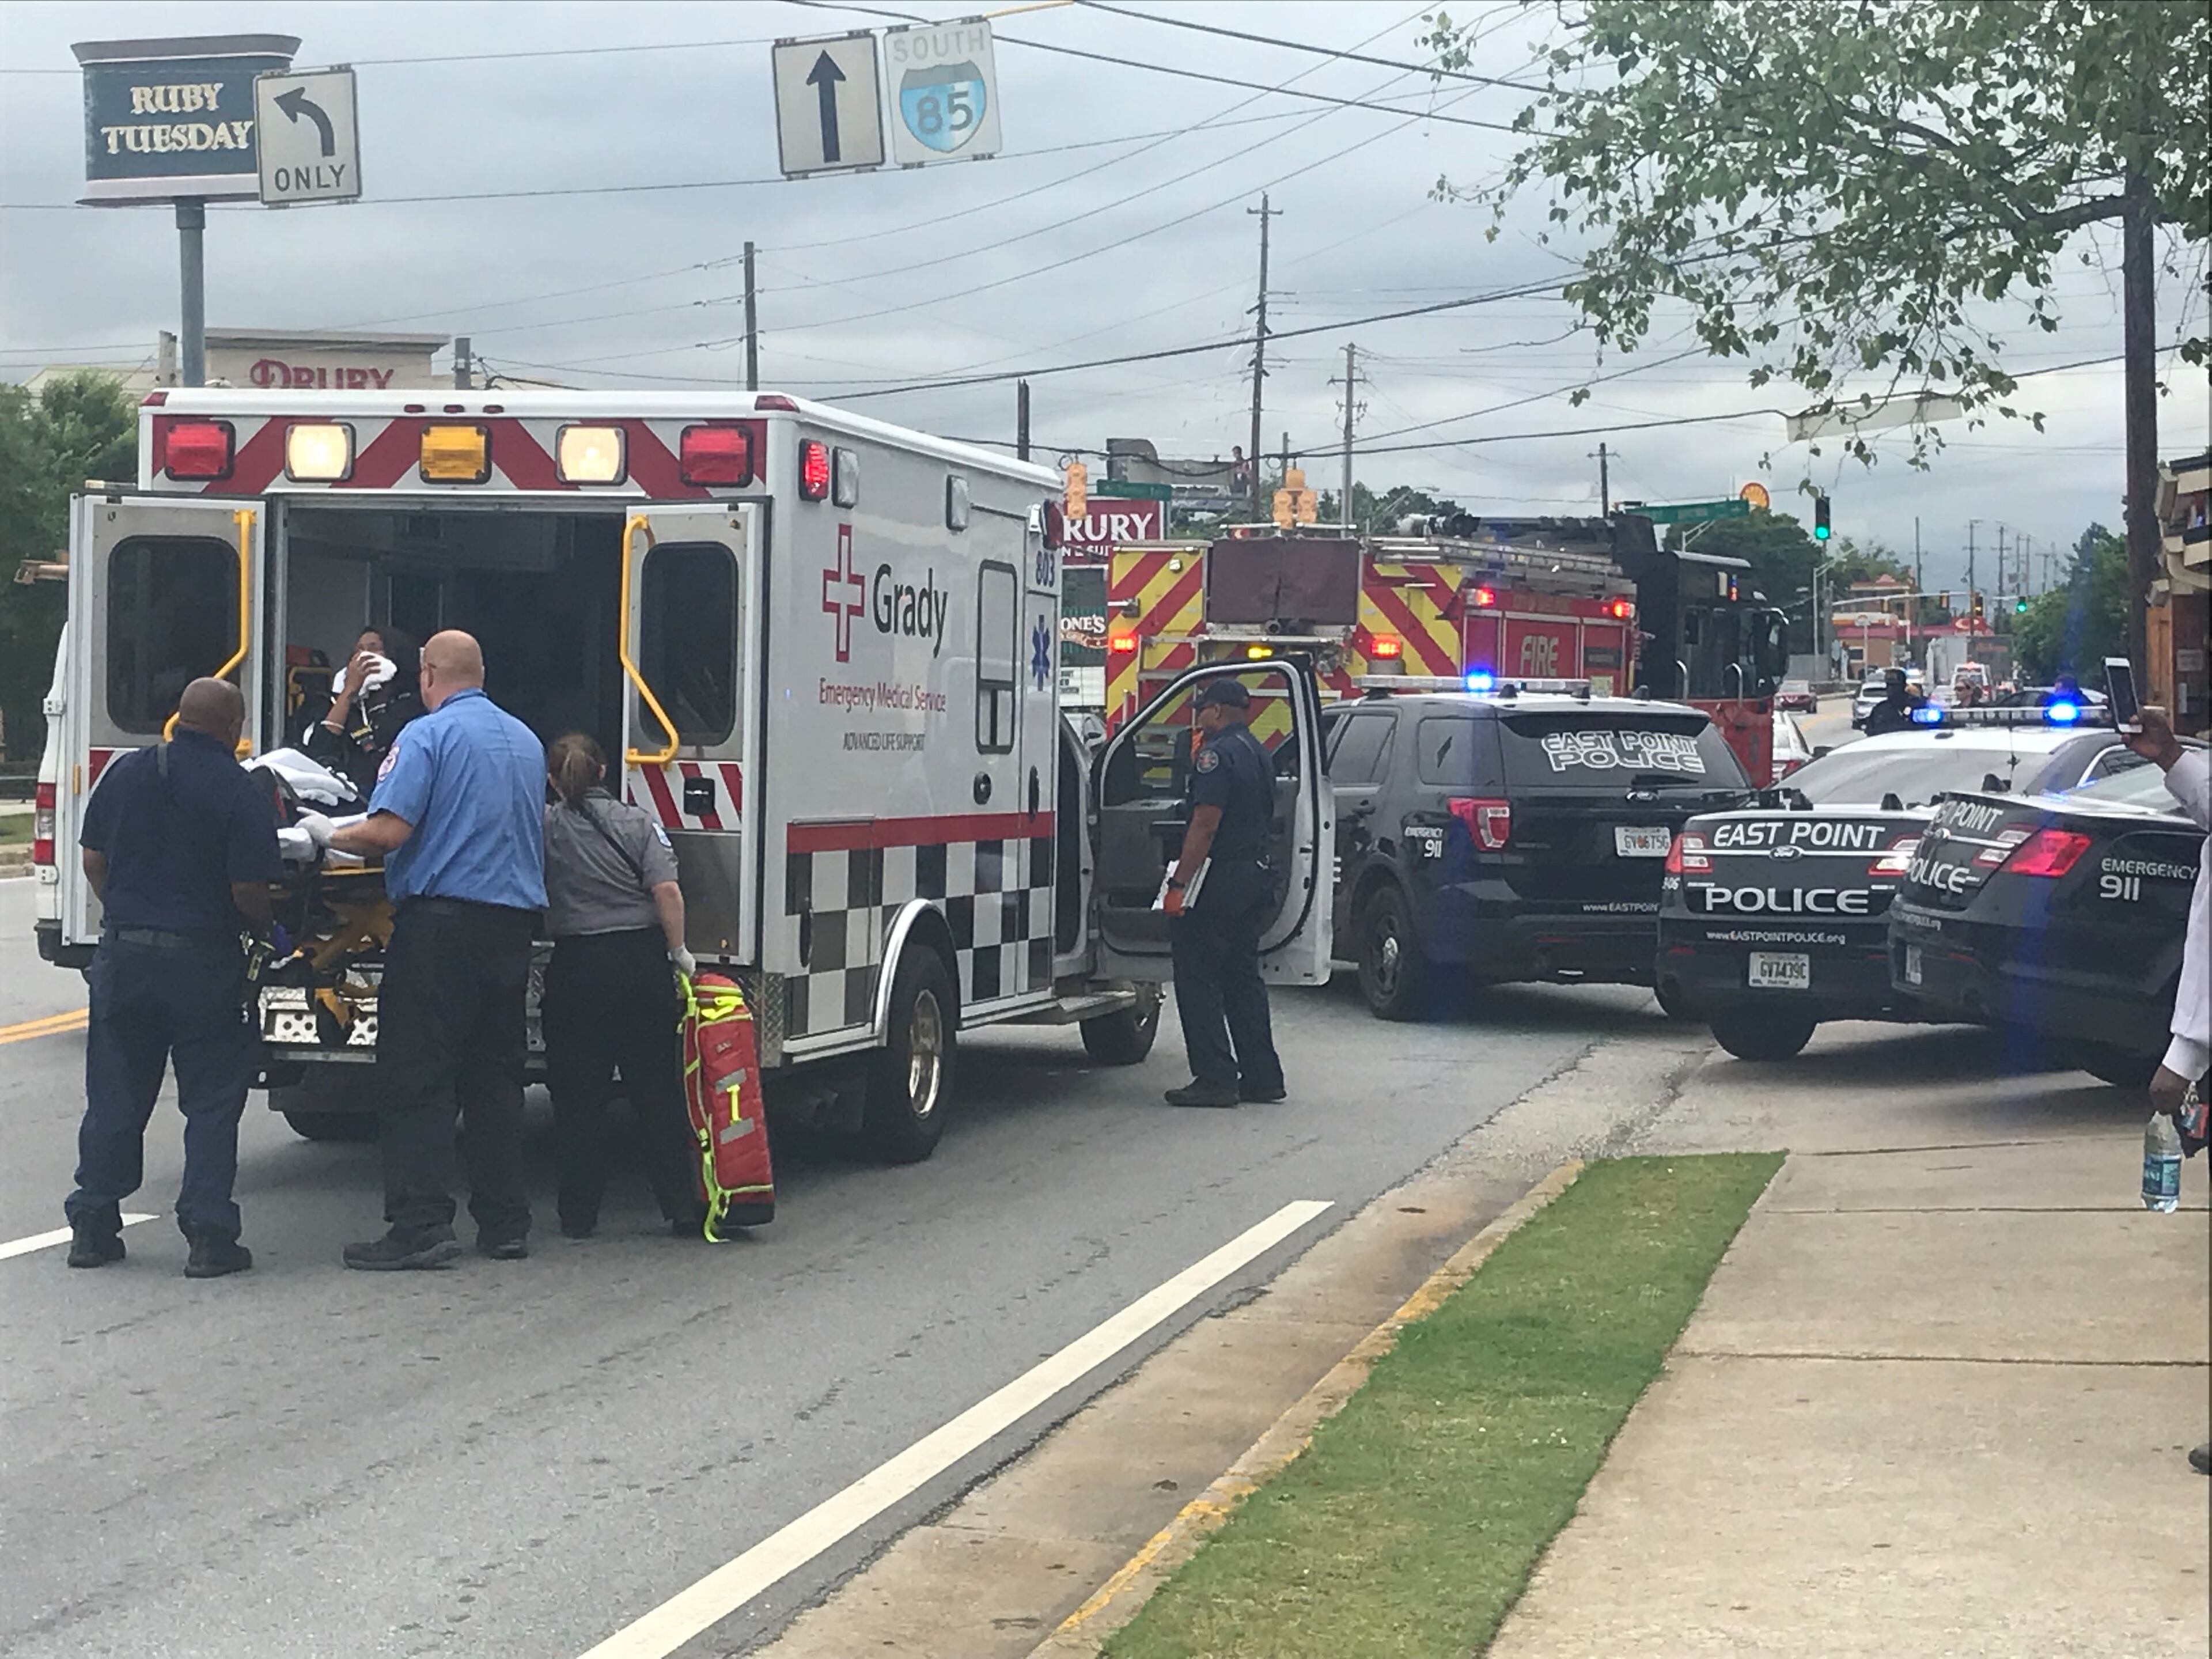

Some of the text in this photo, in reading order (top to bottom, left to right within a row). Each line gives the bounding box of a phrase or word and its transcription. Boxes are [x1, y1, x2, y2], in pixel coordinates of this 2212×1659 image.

[893, 29, 986, 63] SOUTH
[130, 82, 224, 115] RUBY
[917, 91, 974, 135] 85
[101, 120, 255, 154] TUESDAY
[274, 164, 347, 192] ONLY
[873, 563, 949, 659] Grady
[1520, 635, 1560, 677] FIRE
[819, 677, 946, 713] Emergency Medical Service
[843, 732, 926, 752] ADVANCED LIFE SUPPORT
[1541, 730, 1698, 756] EAST POINT
[1548, 749, 1706, 774] POLICE
[1949, 801, 2004, 833] POINT
[1423, 839, 1442, 858] 911
[1713, 822, 1886, 849] EAST POINT
[1906, 857, 1970, 893] POLICE
[2101, 857, 2198, 880] EMERGENCY
[1705, 887, 1869, 914] POLICE
[2100, 874, 2141, 902] 911
